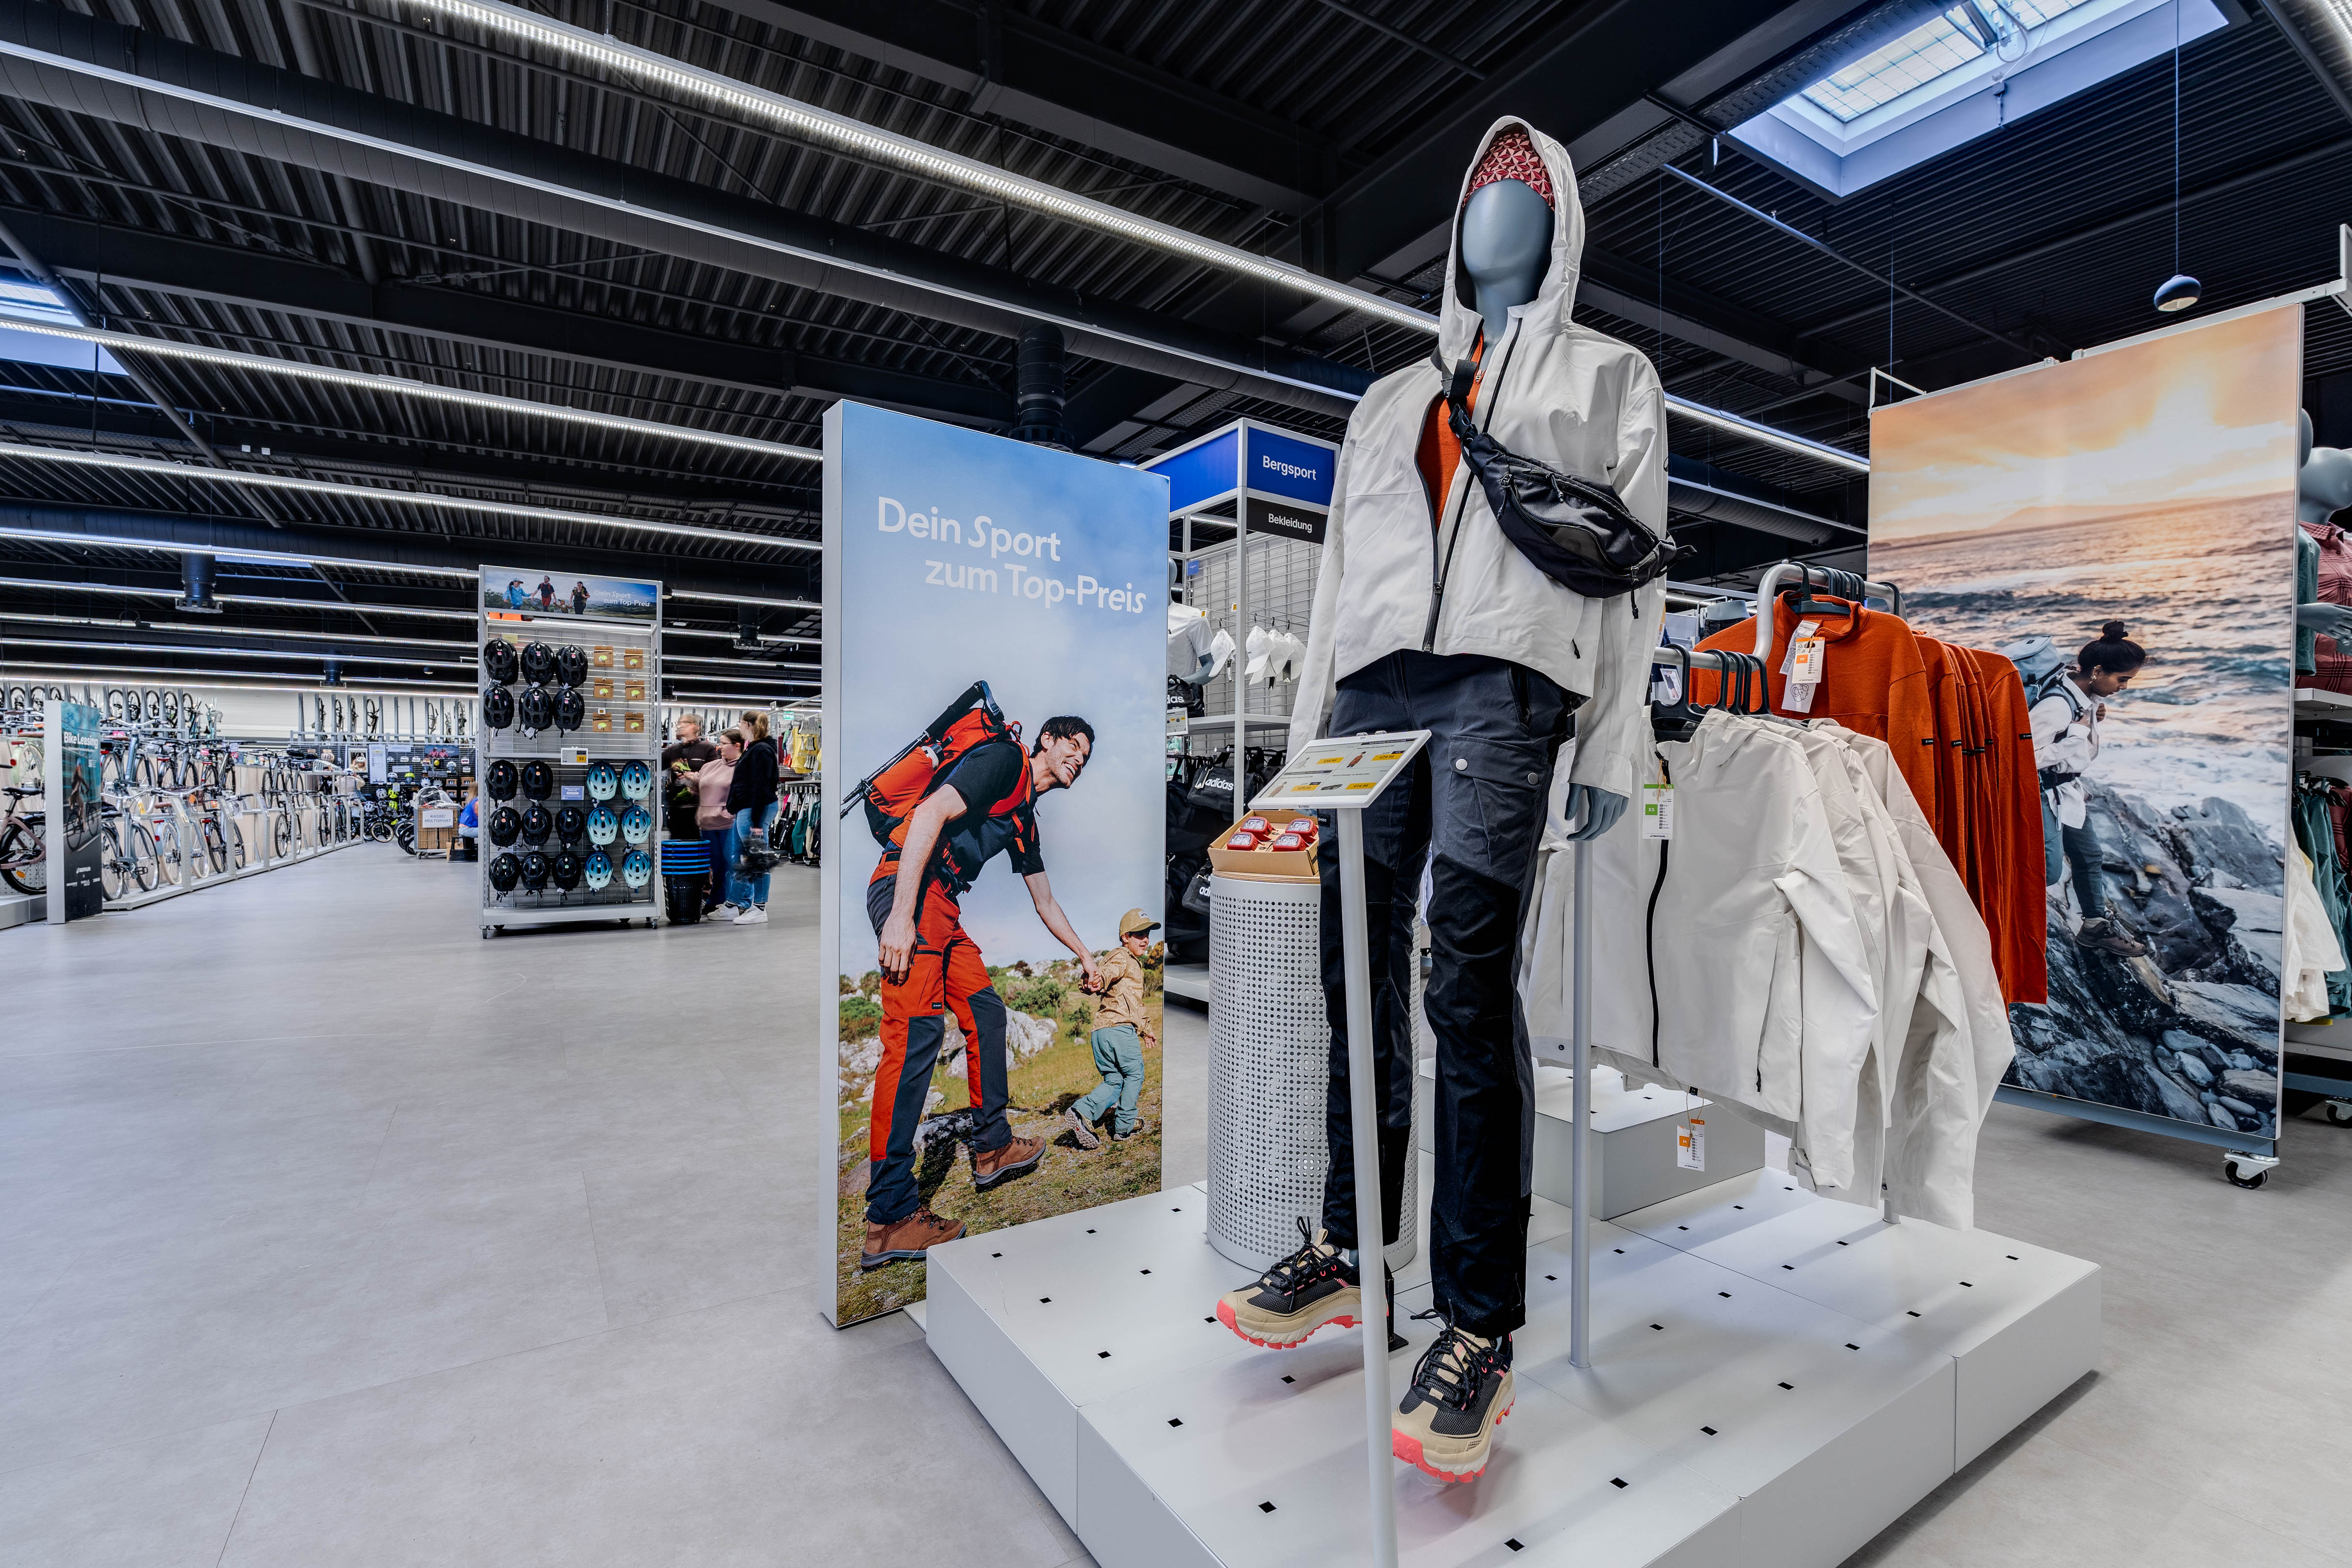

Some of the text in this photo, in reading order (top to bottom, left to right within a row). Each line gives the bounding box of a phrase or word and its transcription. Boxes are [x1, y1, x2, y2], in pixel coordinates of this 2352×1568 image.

[1263, 455, 1317, 480] Bergsport
[878, 496, 1061, 562] Dein Sport
[1268, 513, 1312, 534] Bekleidung
[925, 560, 1147, 613] zum Top-Preis
[619, 599, 651, 607] Top-Preis
[1167, 695, 1185, 704] das
[64, 731, 77, 744] Bike
[77, 733, 98, 749] Leasing
[1205, 777, 1234, 791] adidas
[1199, 886, 1211, 897] adi
